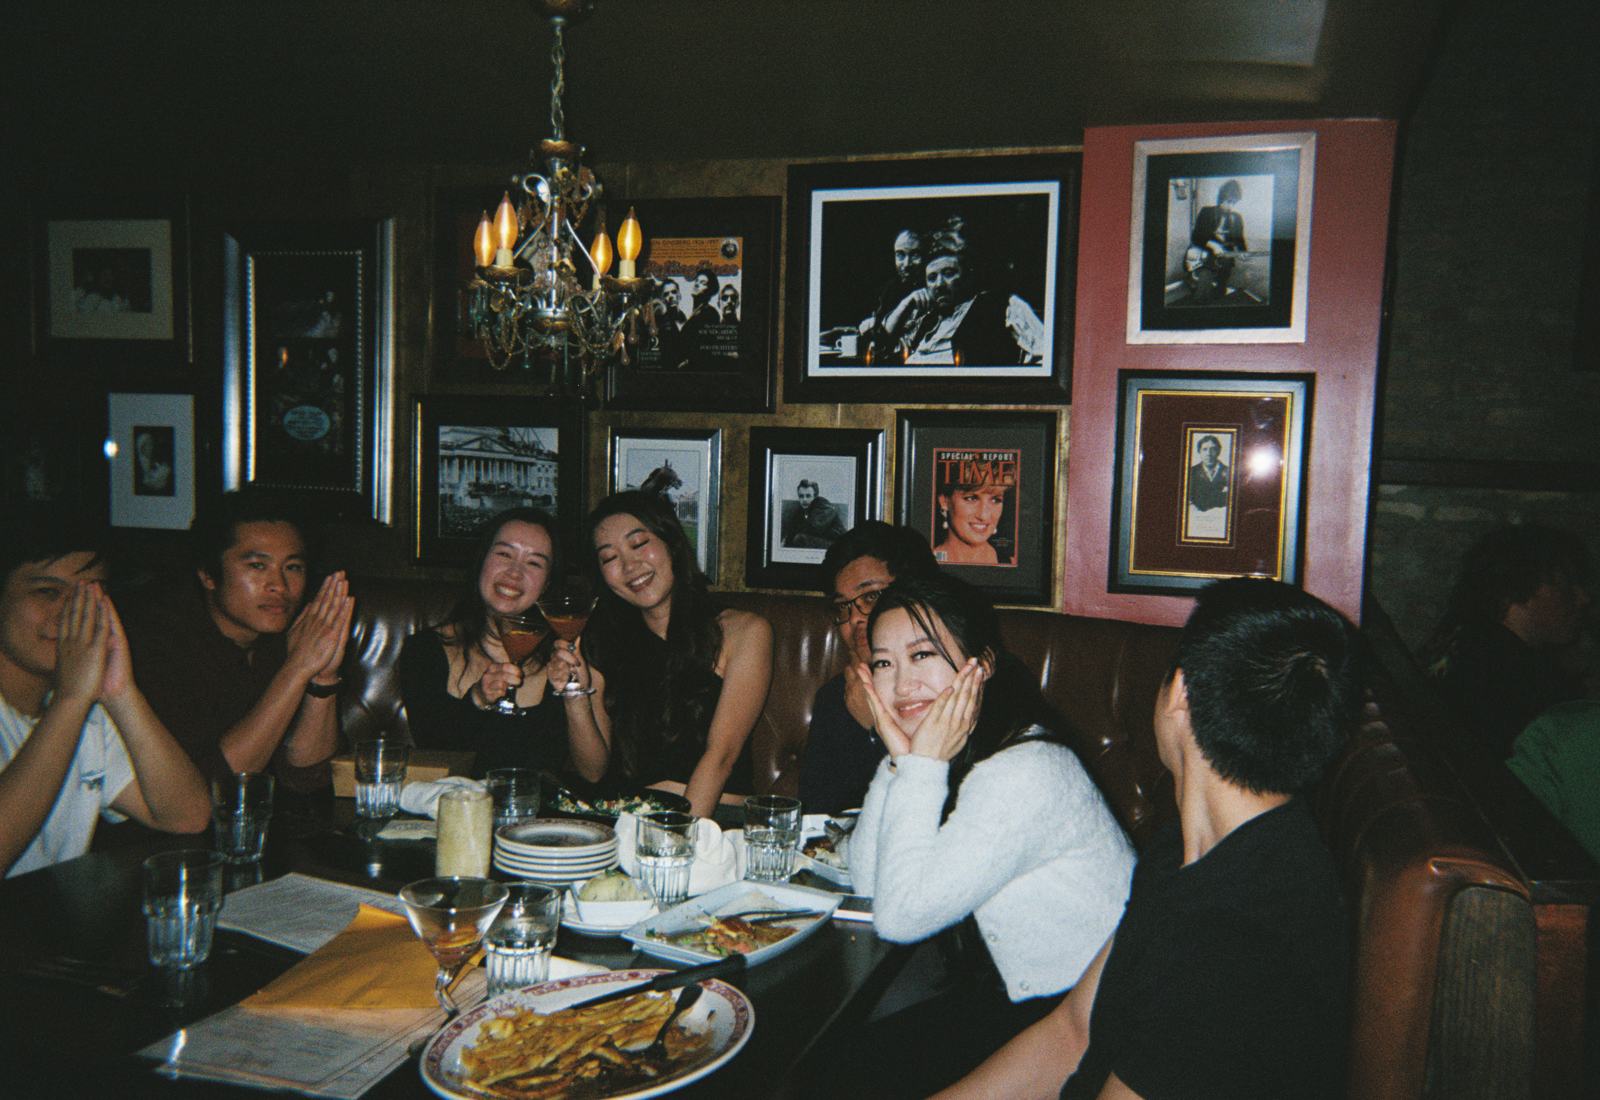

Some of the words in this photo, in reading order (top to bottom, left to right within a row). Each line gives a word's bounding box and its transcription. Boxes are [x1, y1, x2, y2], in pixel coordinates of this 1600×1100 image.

[940, 452, 973, 460] SPECIAL
[983, 453, 1014, 461] REPORT
[938, 460, 1017, 486] TIME
